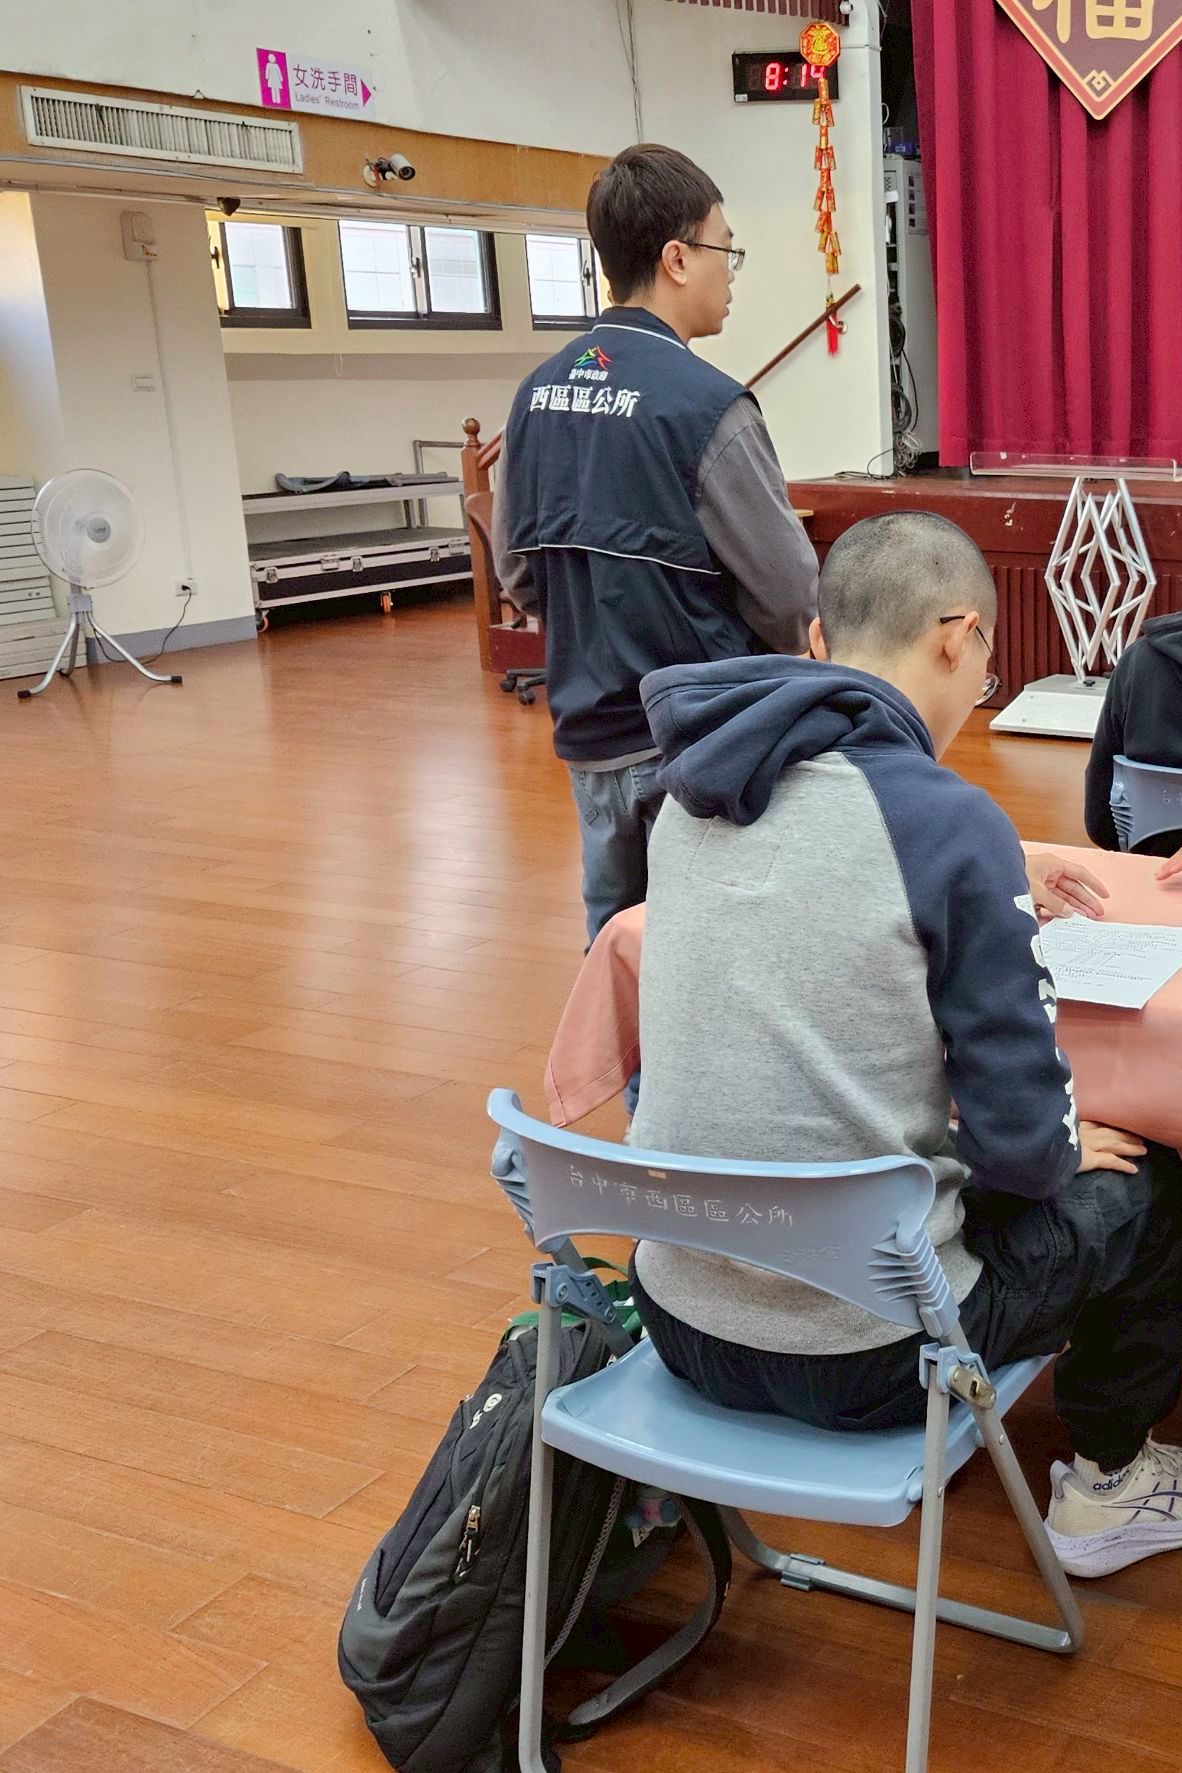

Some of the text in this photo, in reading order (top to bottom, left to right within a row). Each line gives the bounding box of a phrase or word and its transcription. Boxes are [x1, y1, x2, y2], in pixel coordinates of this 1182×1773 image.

[293, 64, 358, 96] 女洗手間
[325, 96, 360, 110] Restroom
[529, 384, 640, 418] 西區區公所
[568, 1164, 794, 1227] 台中市西區區公所
